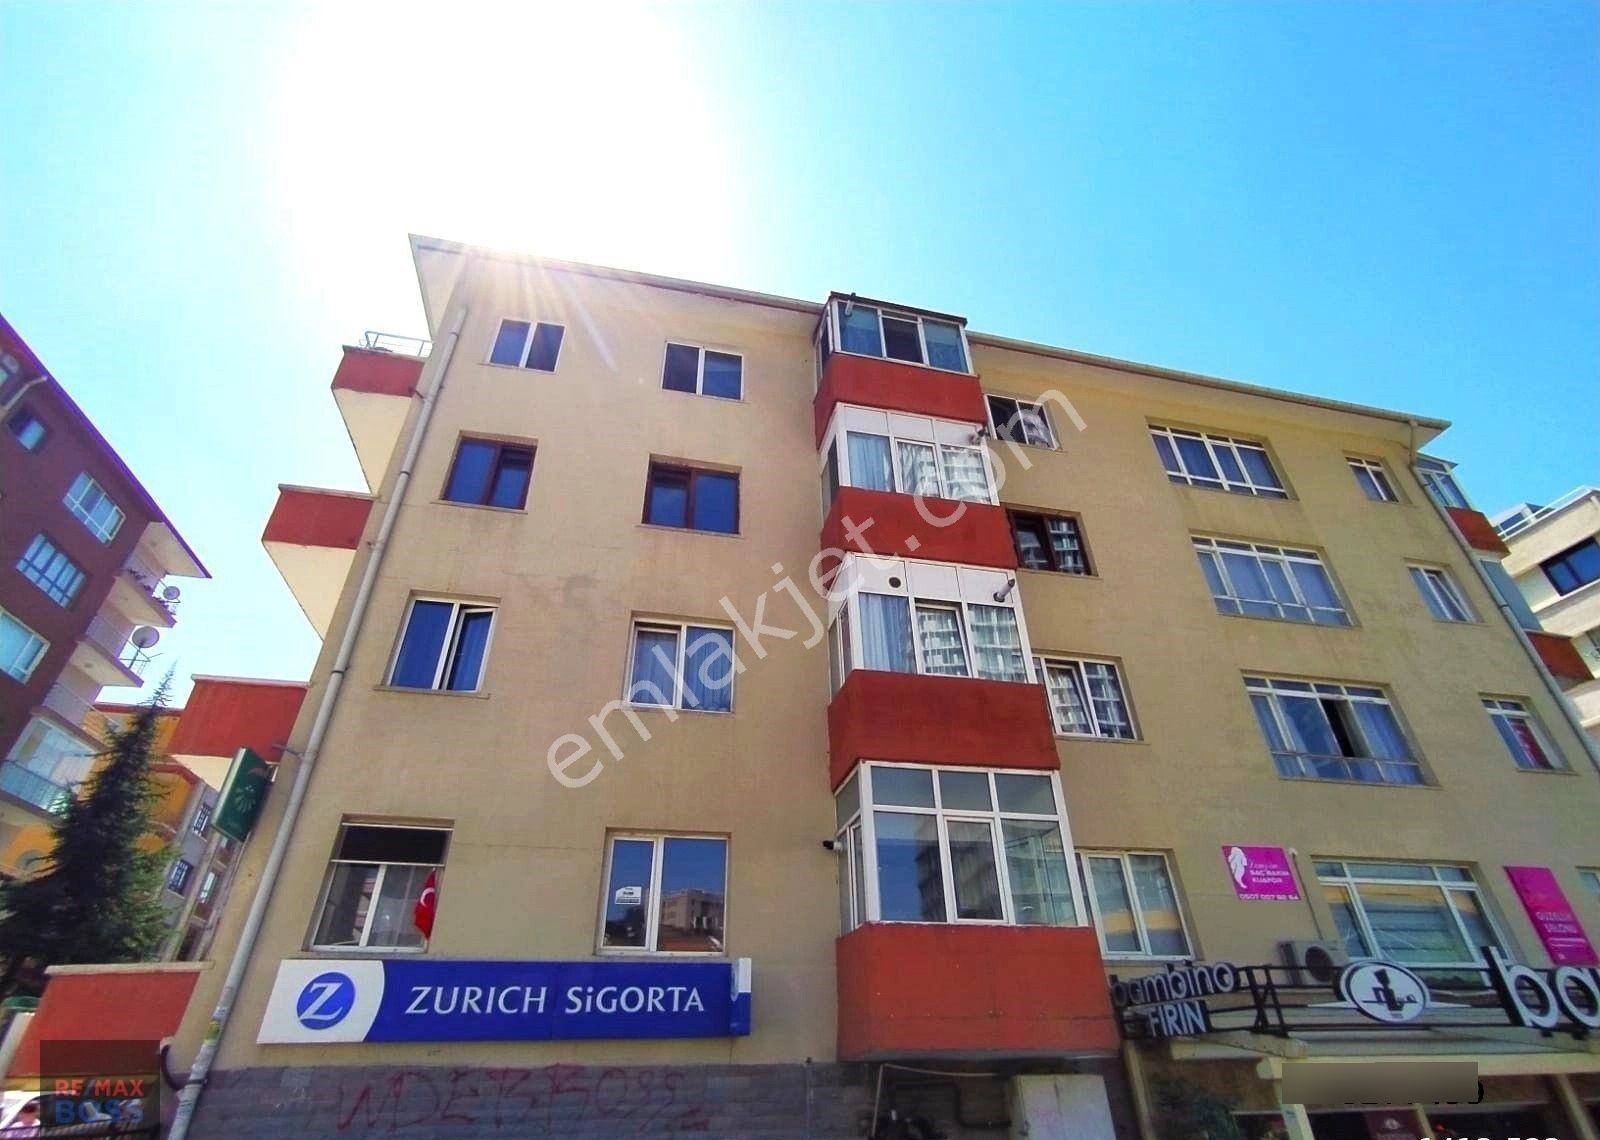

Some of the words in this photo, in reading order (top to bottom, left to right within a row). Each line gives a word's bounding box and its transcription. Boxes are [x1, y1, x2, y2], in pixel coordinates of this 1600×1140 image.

[300, 982, 344, 1021] Z
[406, 986, 546, 1014] ZURICH
[1108, 961, 1236, 1009] bambino
[1145, 1000, 1207, 1037] FIRIN
